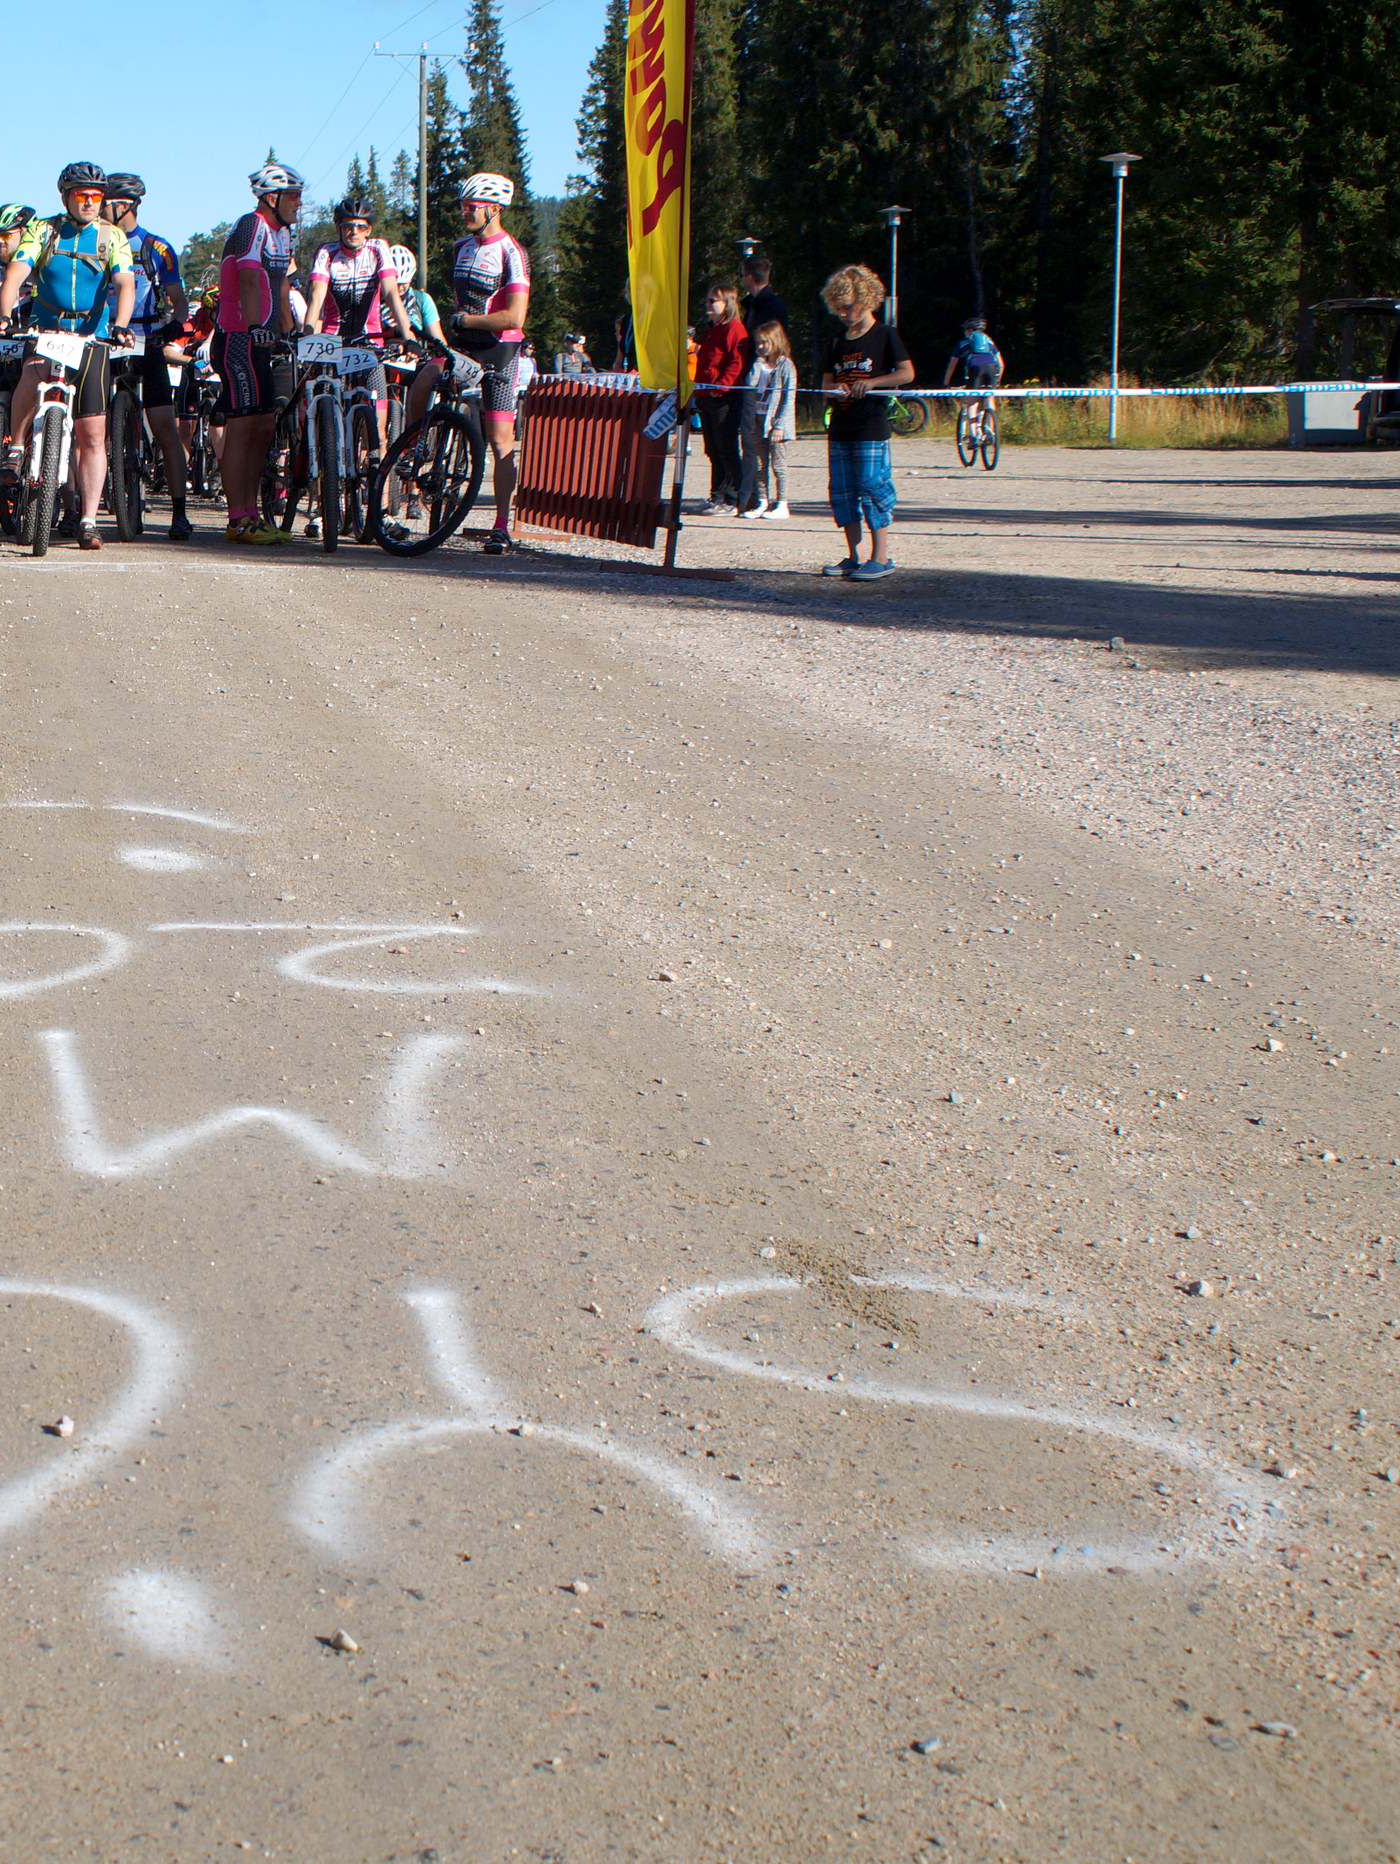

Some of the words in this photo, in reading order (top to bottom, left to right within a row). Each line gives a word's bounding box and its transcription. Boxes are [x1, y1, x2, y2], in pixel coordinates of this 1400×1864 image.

[46, 340, 75, 357] 647
[306, 342, 335, 356] 730
[343, 354, 371, 368] 732
[459, 360, 479, 378] 728
